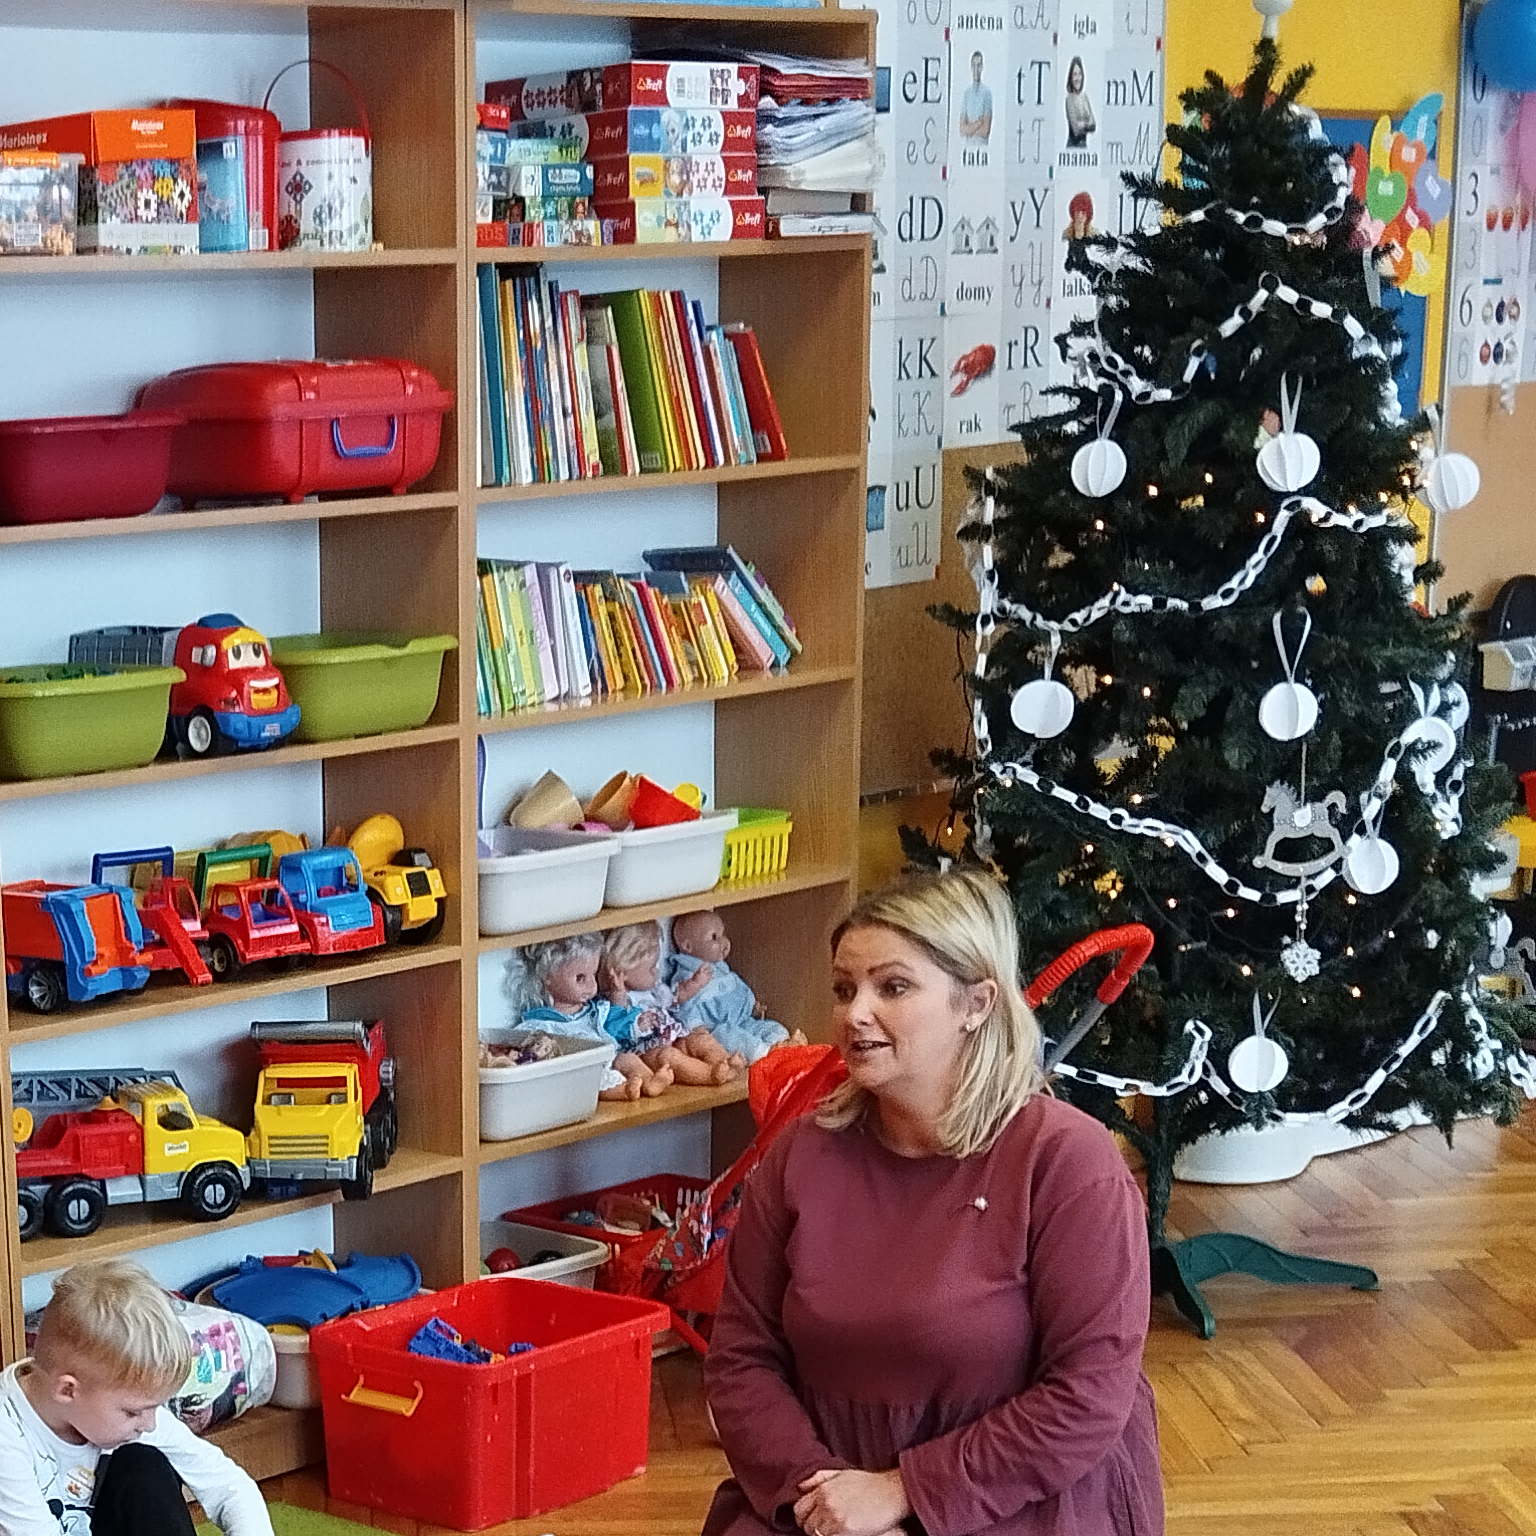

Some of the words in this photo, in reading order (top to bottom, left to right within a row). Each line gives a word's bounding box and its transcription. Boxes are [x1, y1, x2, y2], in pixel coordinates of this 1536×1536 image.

[957, 13, 1003, 31] antena
[901, 57, 942, 104] eE
[1016, 60, 1051, 106] tT
[1106, 68, 1155, 107] mM
[962, 149, 989, 167] tata
[1058, 150, 1098, 167] mama
[897, 195, 944, 243] dD
[1010, 187, 1050, 243] yY
[956, 281, 994, 305] domy
[897, 337, 939, 381] kK
[1006, 325, 1043, 371] rR
[959, 412, 982, 435] rak
[895, 463, 938, 512] uU
